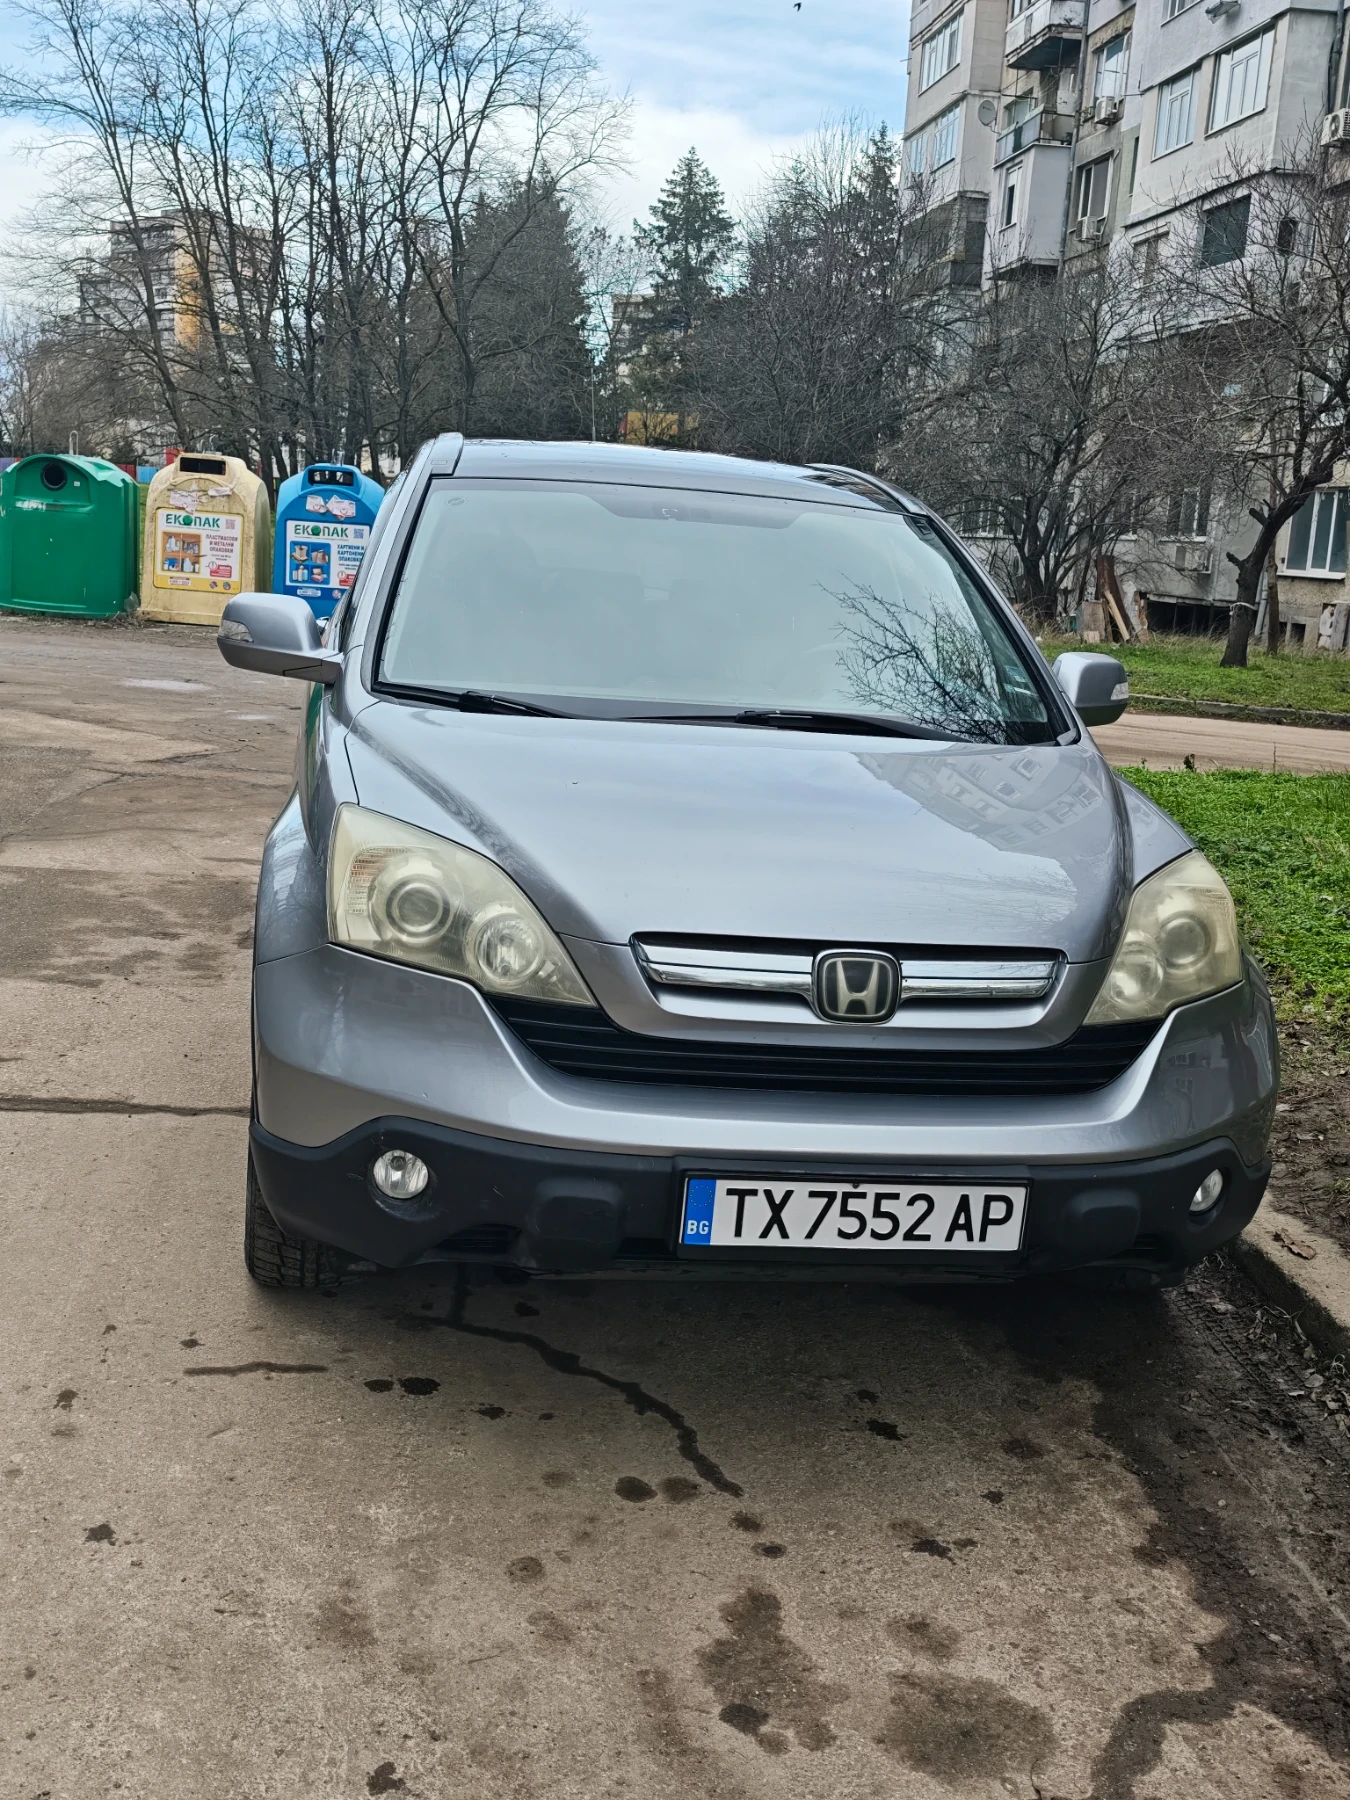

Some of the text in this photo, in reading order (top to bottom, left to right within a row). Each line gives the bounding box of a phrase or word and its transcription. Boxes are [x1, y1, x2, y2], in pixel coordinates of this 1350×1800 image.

[165, 513, 220, 528] ЕКОПАК
[294, 524, 349, 538] ЕКОПАК
[726, 1187, 1014, 1243] TX 7552 AP
[687, 1219, 709, 1236] BG
